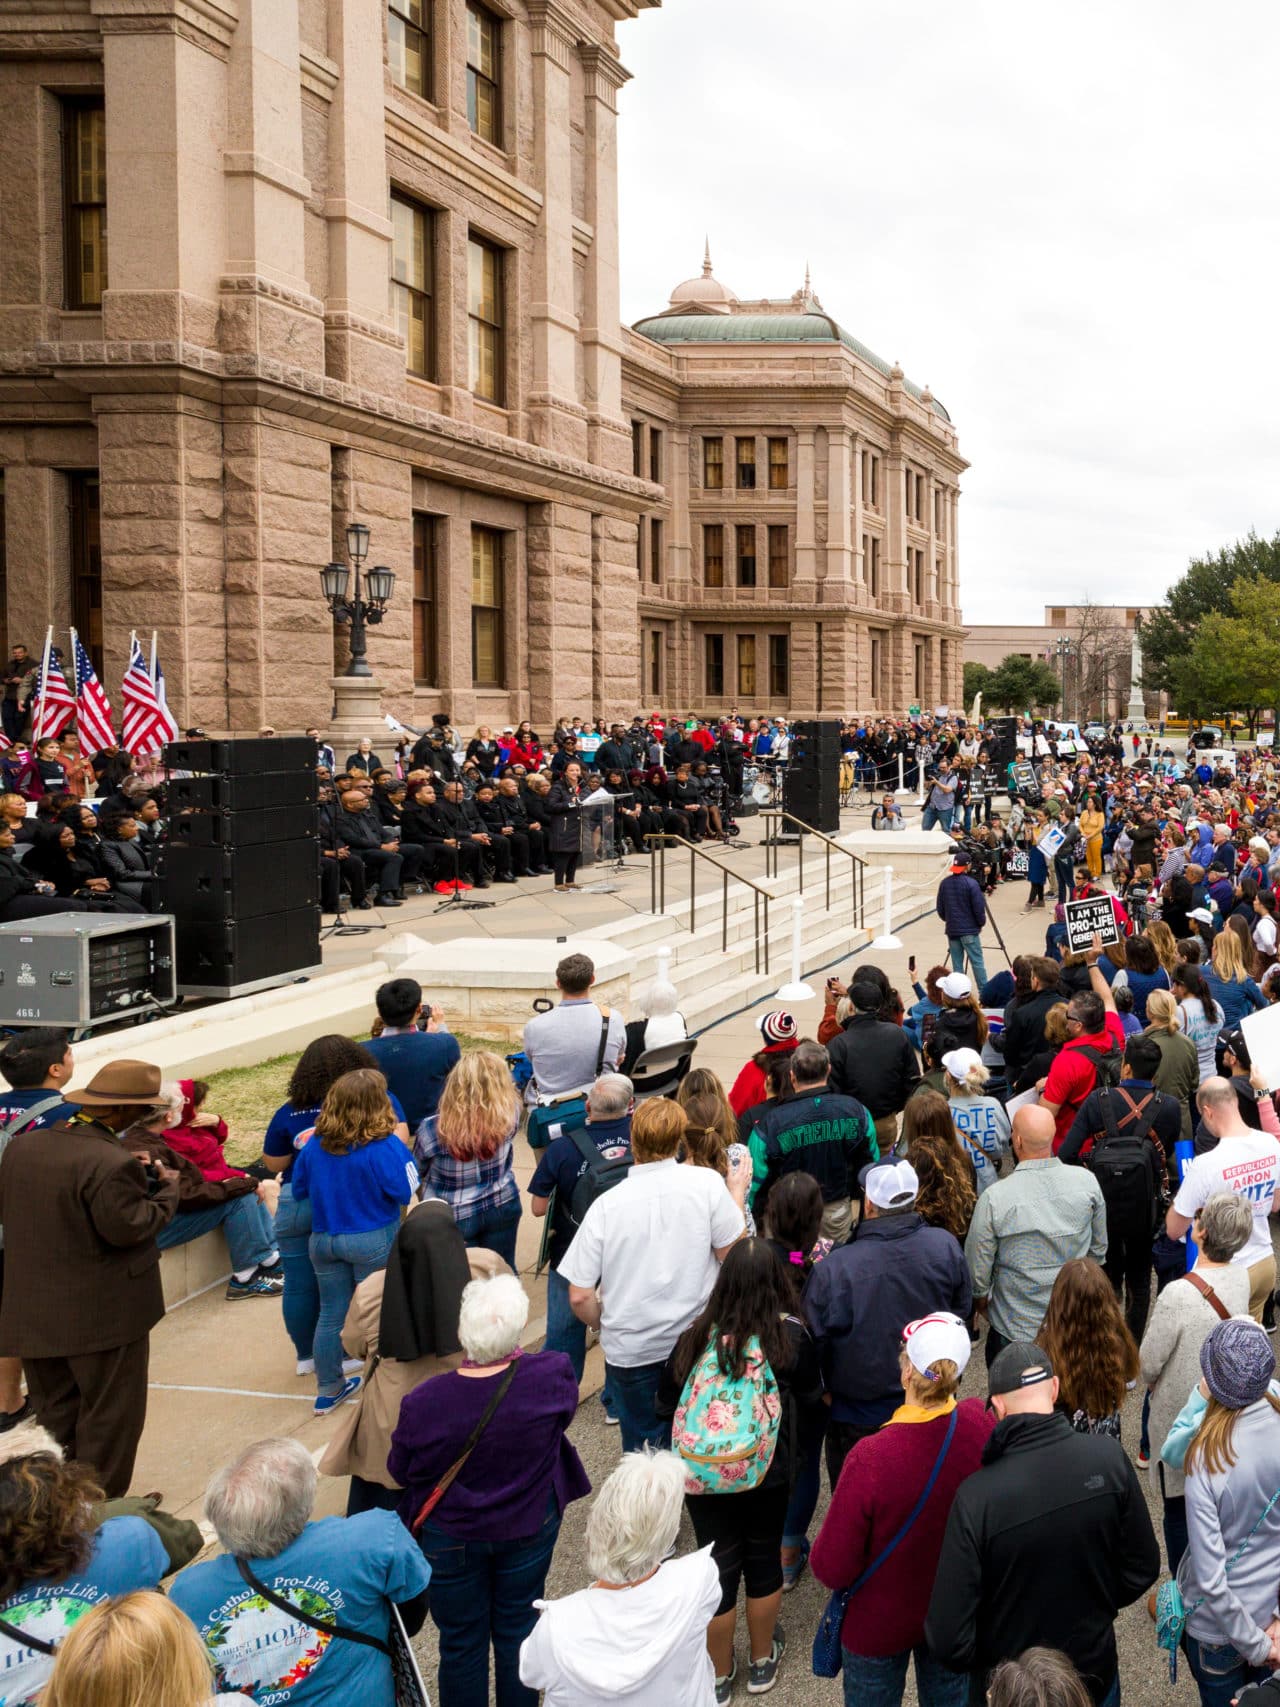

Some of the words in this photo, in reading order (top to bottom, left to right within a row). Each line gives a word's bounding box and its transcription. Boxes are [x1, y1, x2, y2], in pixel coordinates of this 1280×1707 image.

[1070, 911, 1074, 921] I
[1077, 908, 1090, 919] AM
[1092, 904, 1110, 916] THE
[1070, 913, 1114, 934] PRO-LIFE
[1072, 926, 1115, 944] GENERTION
[1225, 1156, 1276, 1178] REPUBLICAN
[1233, 1170, 1271, 1190] AARON
[1240, 1180, 1276, 1201] ITZ
[35, 1583, 99, 1601] Pro-Life
[274, 1575, 330, 1594] Pro-Life
[327, 1588, 347, 1611] Day
[260, 1690, 292, 1707] 2020
